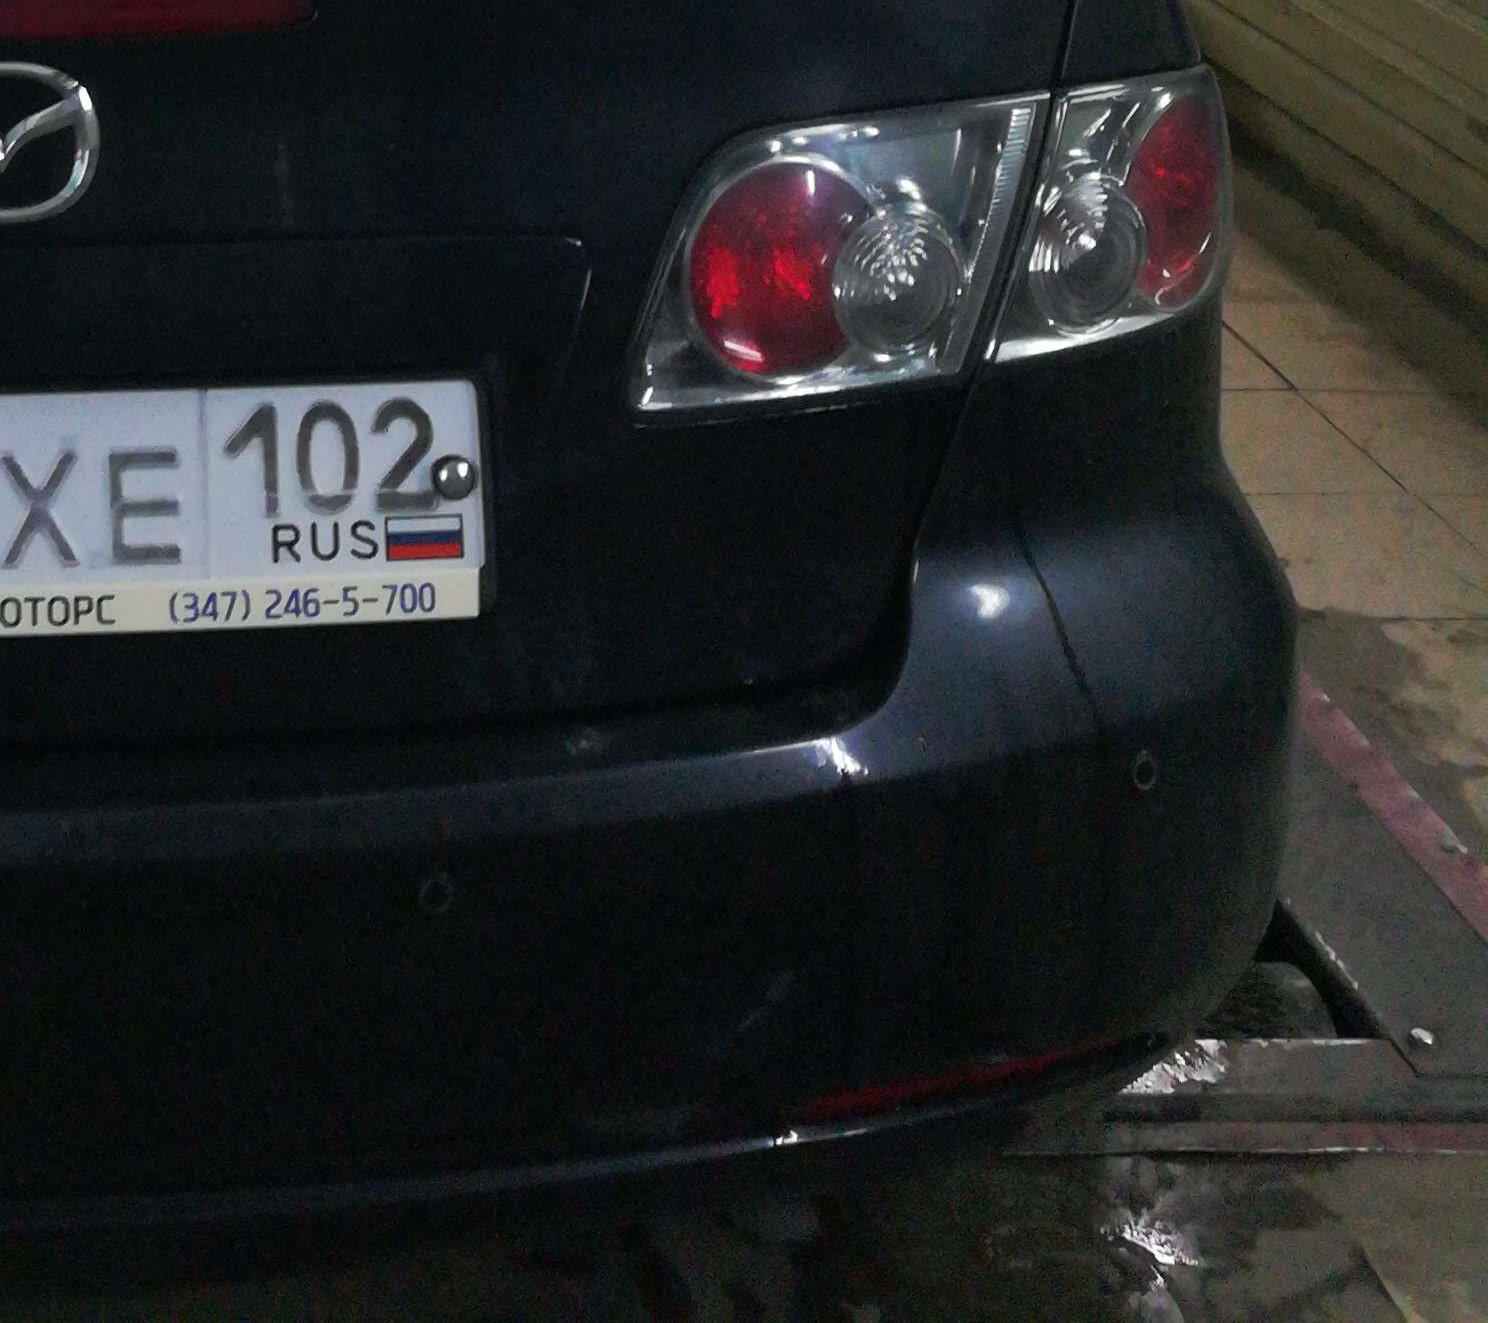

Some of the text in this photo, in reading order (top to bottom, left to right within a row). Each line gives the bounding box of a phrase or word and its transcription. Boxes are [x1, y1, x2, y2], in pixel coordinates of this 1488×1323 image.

[223, 397, 440, 519] 102
[271, 520, 380, 564] RUS
[167, 589, 251, 626] (347)
[264, 582, 437, 620] 246-5-700
